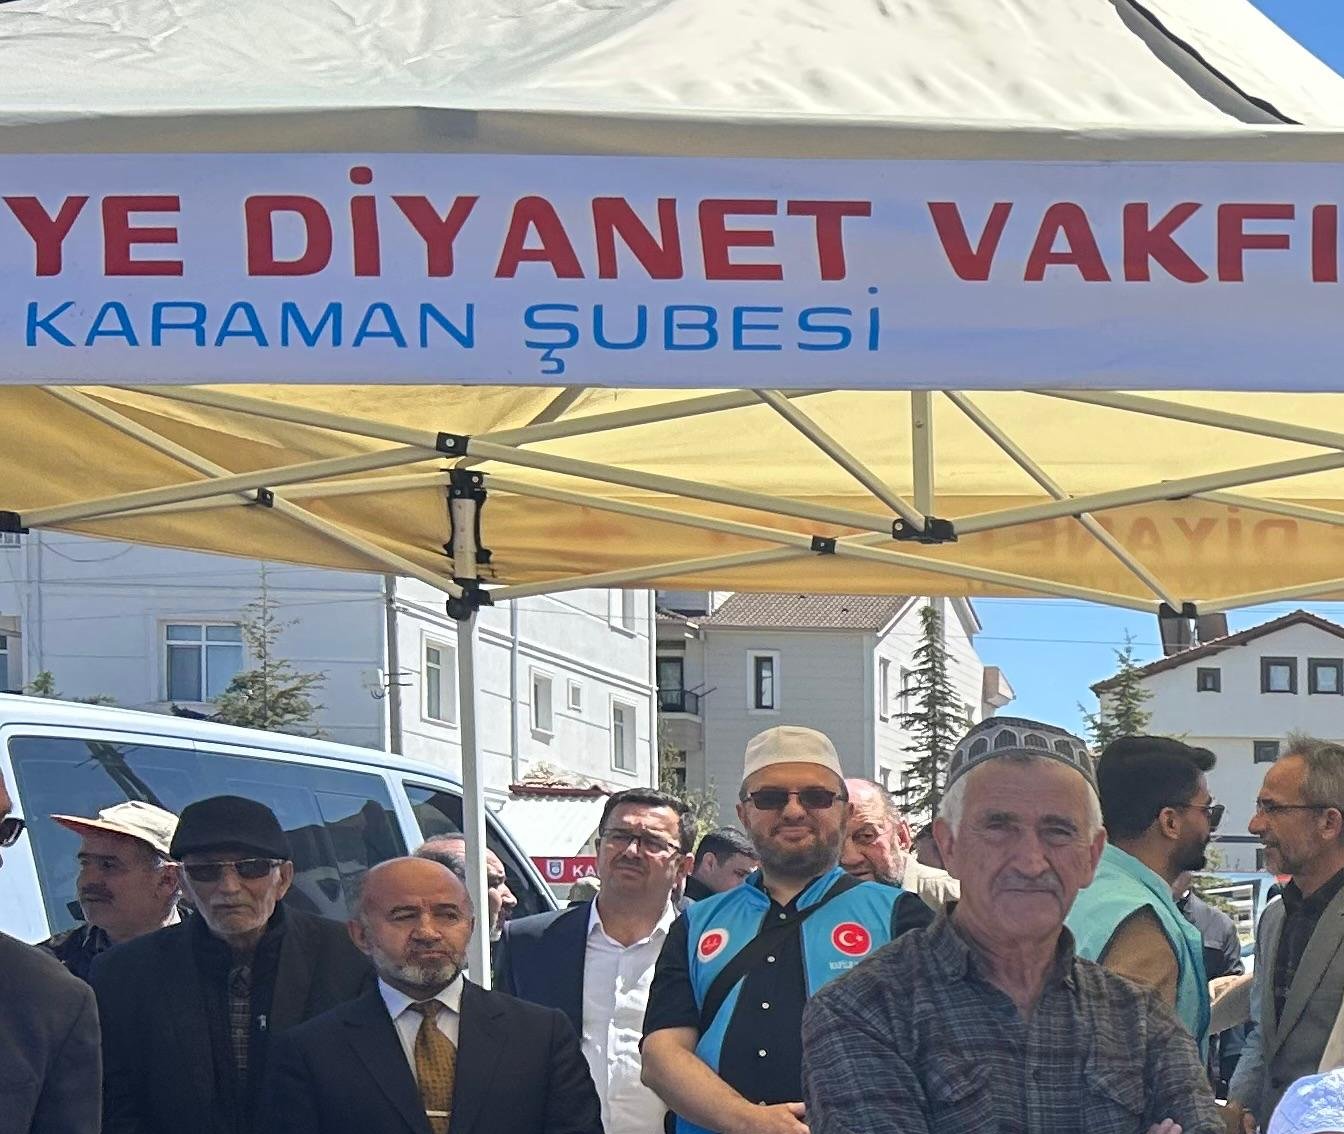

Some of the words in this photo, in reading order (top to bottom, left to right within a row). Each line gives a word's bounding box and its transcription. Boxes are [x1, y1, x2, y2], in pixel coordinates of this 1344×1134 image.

[5, 195, 183, 277] YE
[244, 166, 872, 281] DİYANET
[928, 201, 1338, 284] VAKFI
[25, 299, 476, 350] KARAMAN
[522, 286, 881, 375] ŞUBESİ
